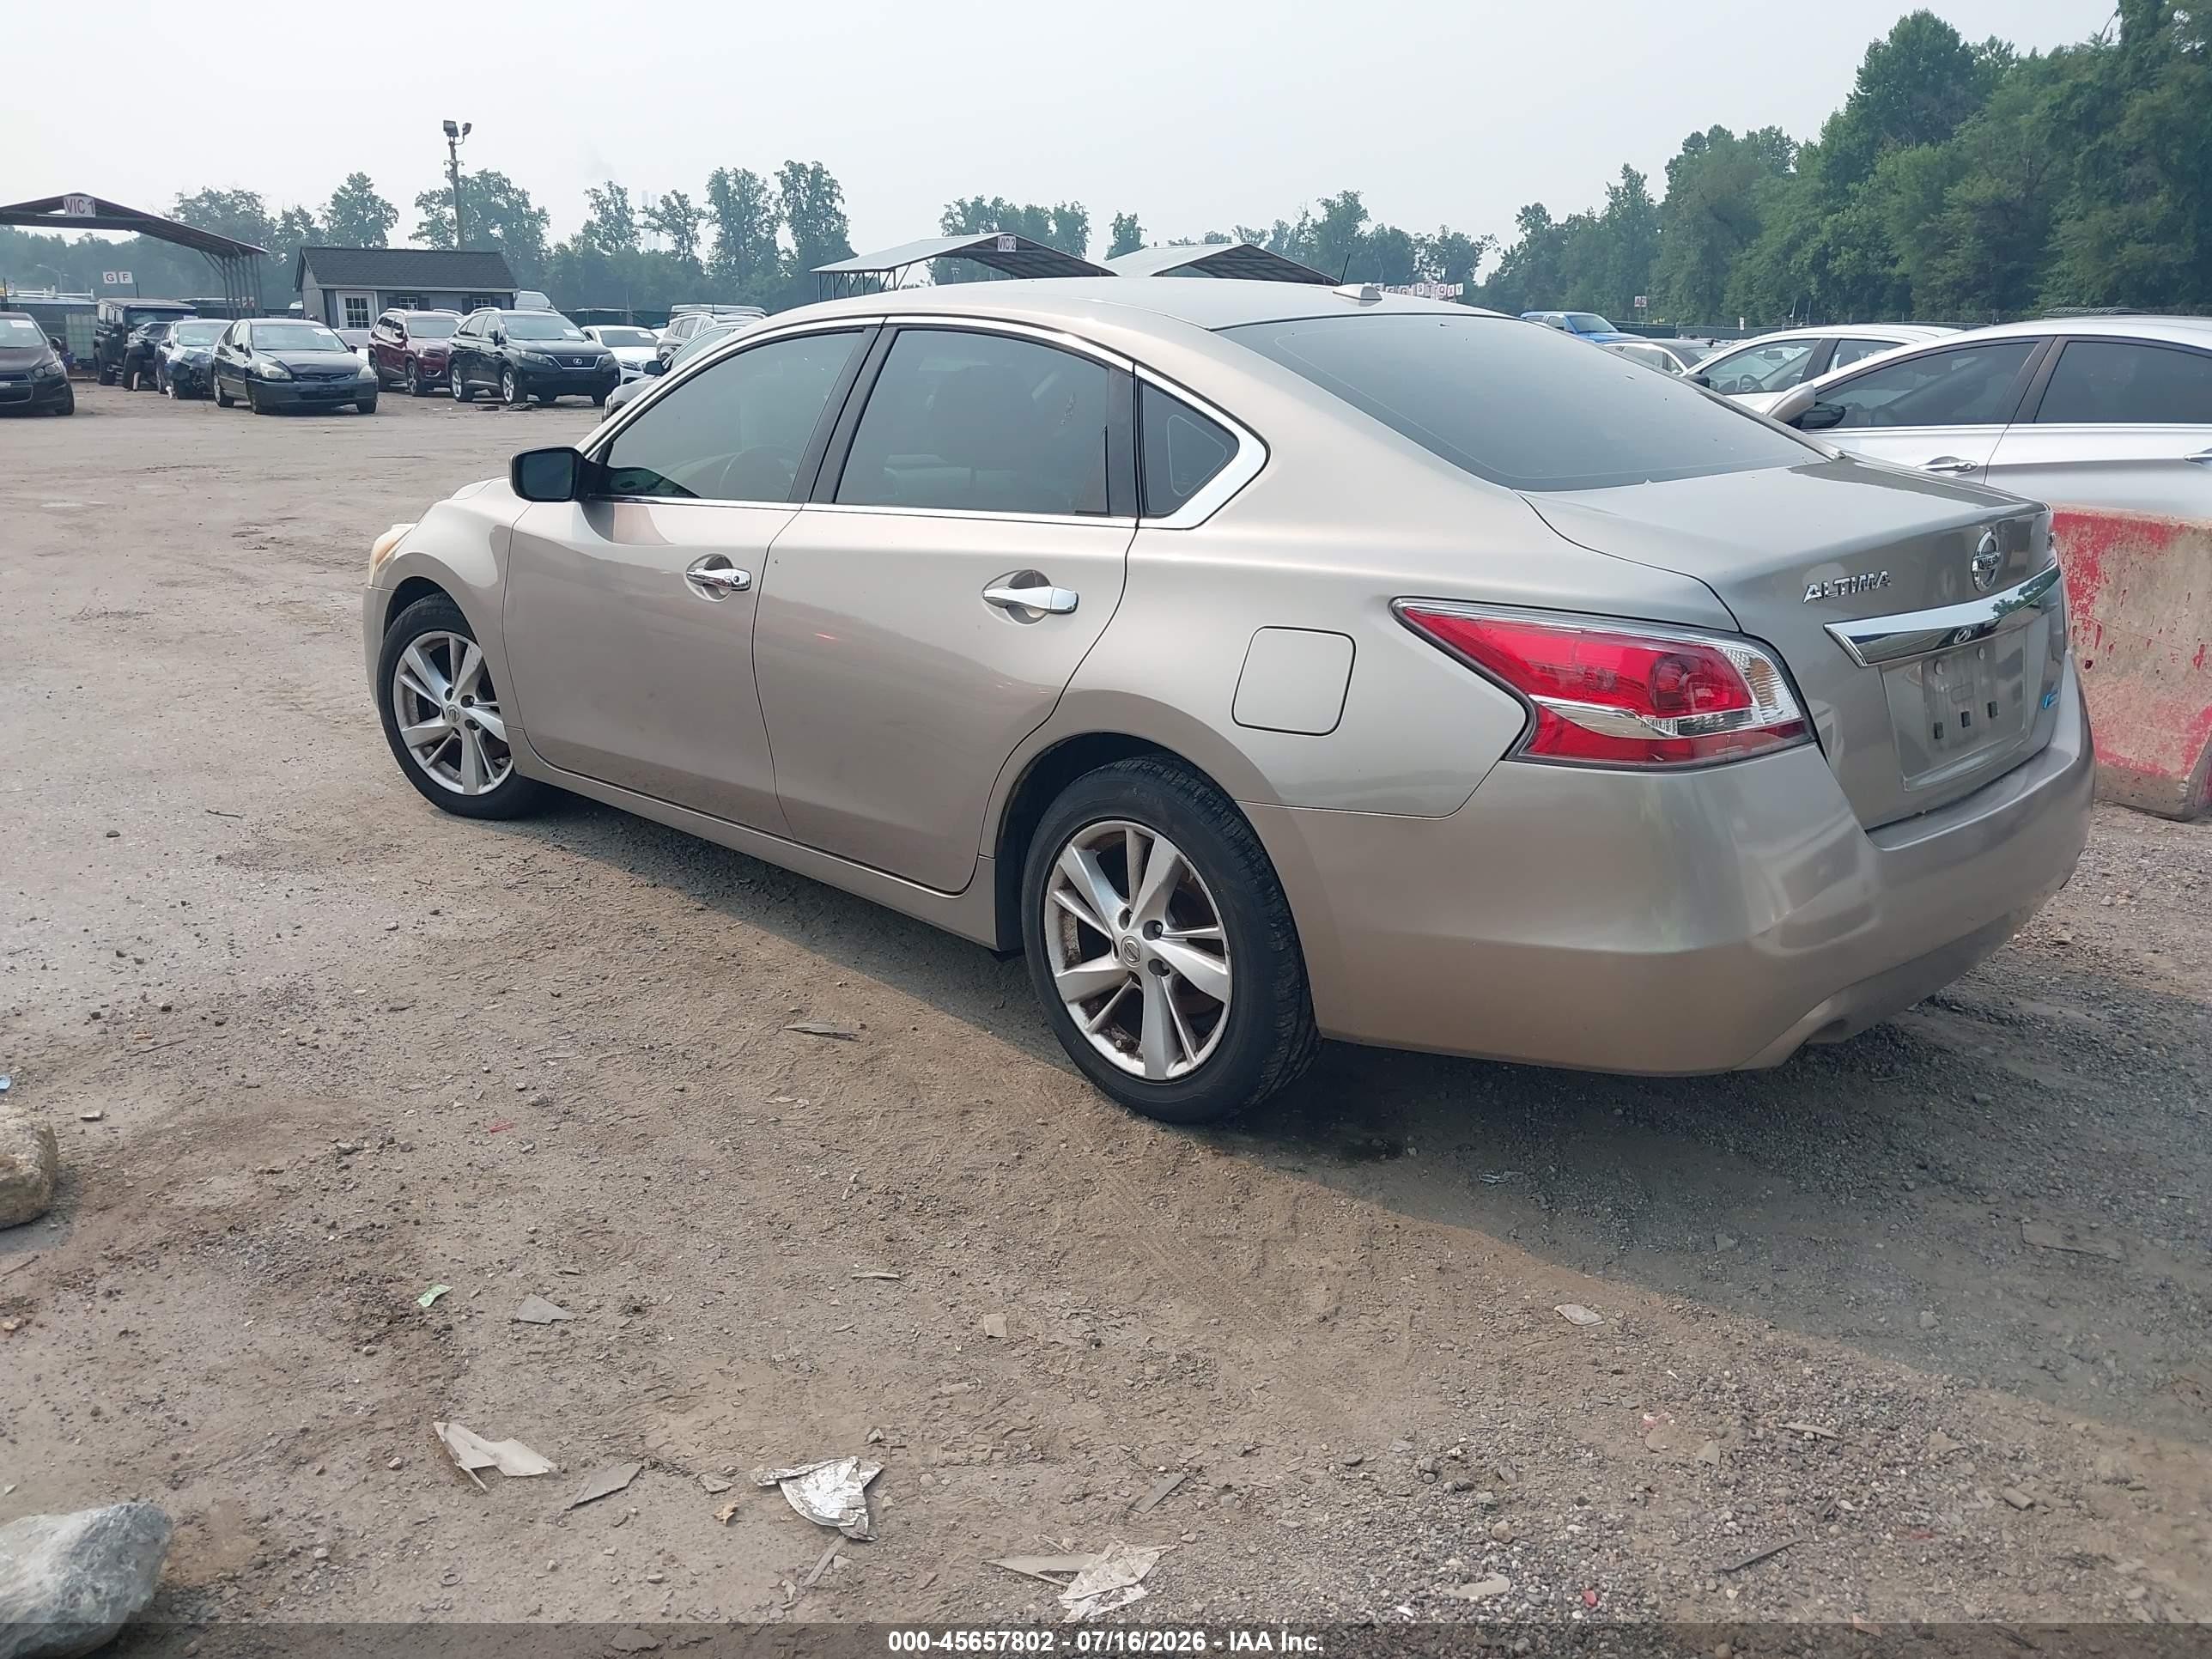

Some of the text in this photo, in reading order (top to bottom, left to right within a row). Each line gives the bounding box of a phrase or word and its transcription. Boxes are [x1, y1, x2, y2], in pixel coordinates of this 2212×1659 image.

[64, 198, 94, 215] VIC 1
[999, 238, 1016, 250] VIC 2
[106, 273, 114, 282] G
[122, 273, 130, 282] F
[1418, 284, 1423, 293] S
[1449, 286, 1453, 295] X
[1802, 569, 1892, 604] ALTIMA
